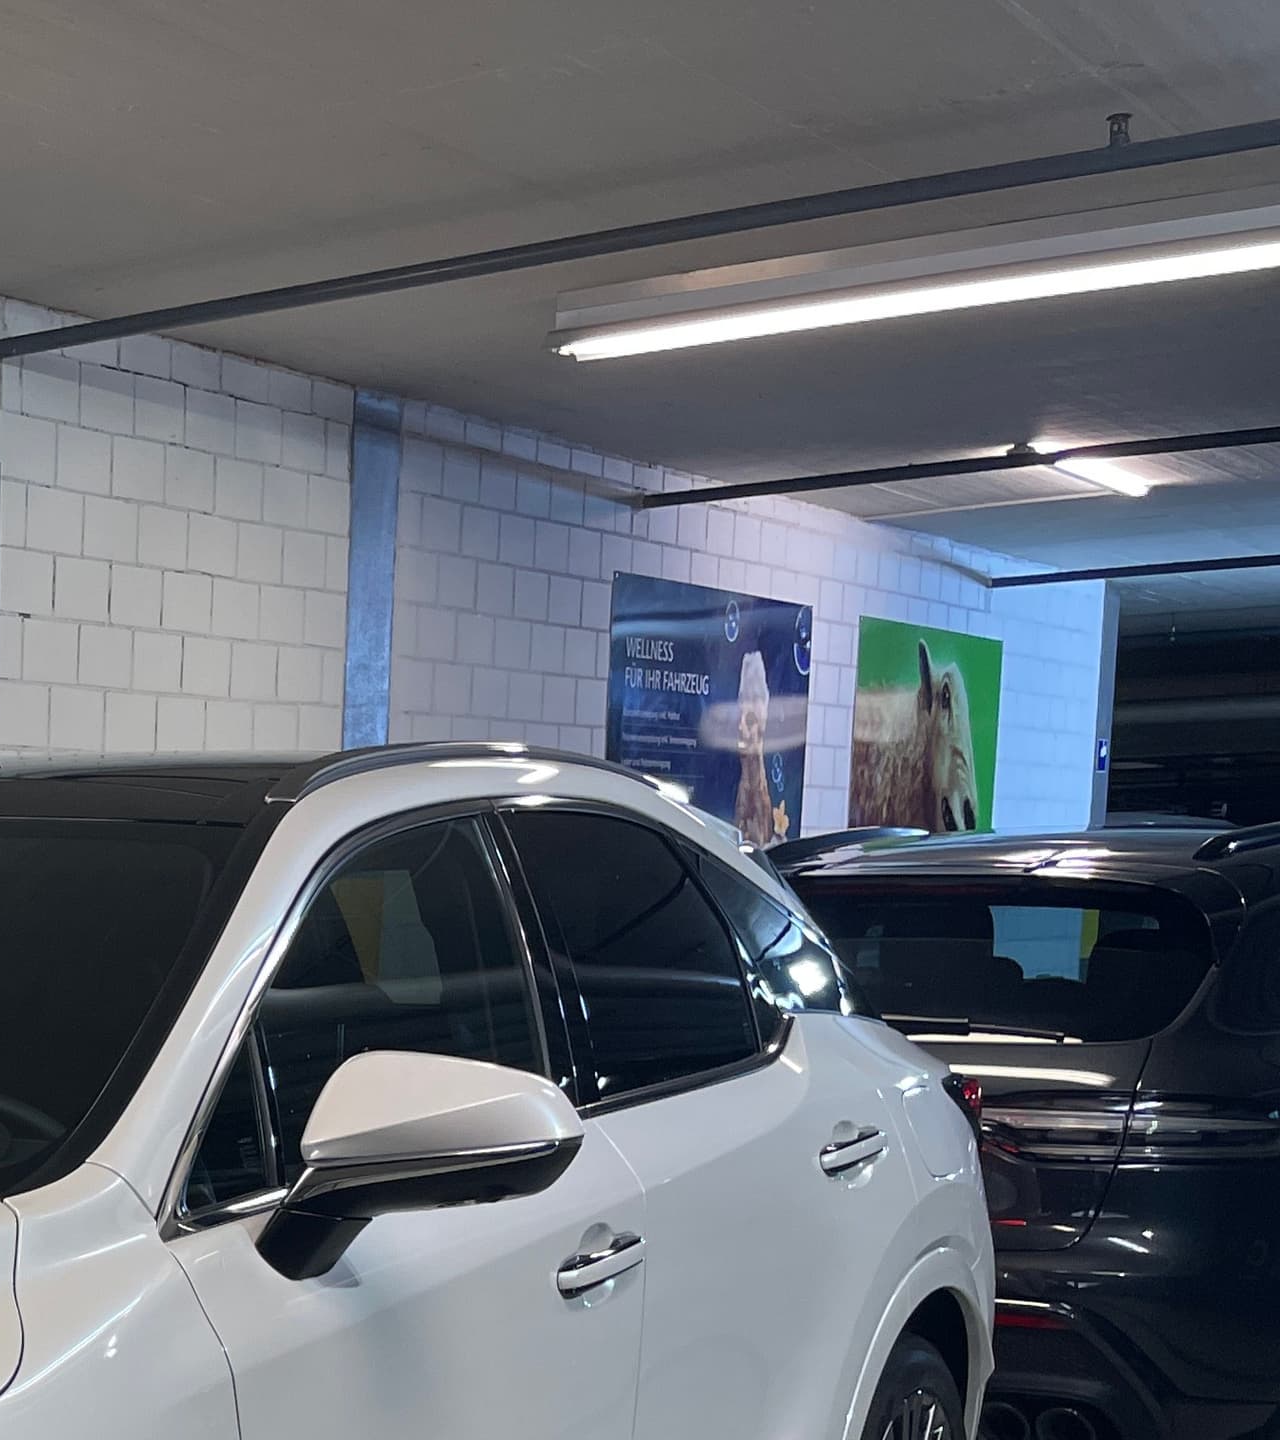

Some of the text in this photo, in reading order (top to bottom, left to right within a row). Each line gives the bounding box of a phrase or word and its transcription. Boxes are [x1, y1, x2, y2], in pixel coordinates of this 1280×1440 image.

[625, 636, 674, 662] WELLNESS
[624, 662, 710, 696] FÜR IHR FAHRZEUG
